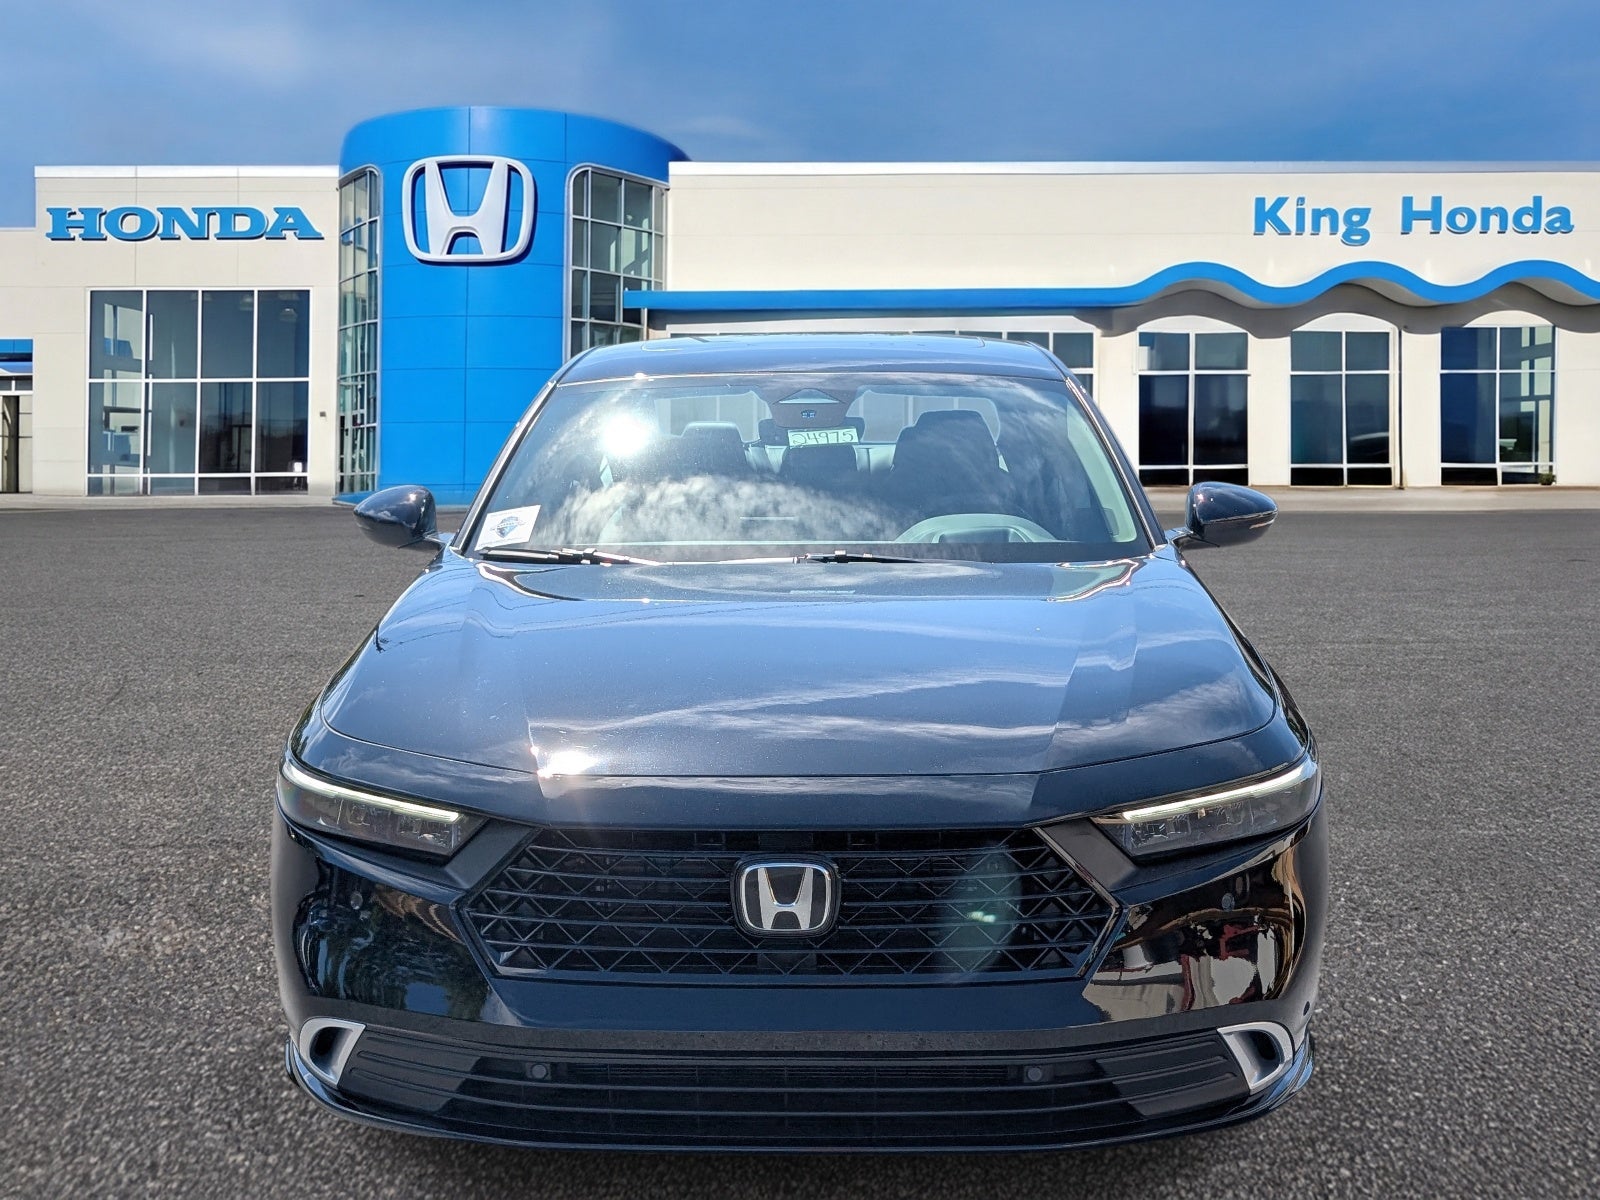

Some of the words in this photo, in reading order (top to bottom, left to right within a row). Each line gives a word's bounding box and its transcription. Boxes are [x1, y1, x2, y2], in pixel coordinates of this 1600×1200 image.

[45, 206, 325, 242] HONDA
[1253, 196, 1372, 247] King
[1400, 195, 1575, 235] Honda
[791, 431, 854, 445] 24975
